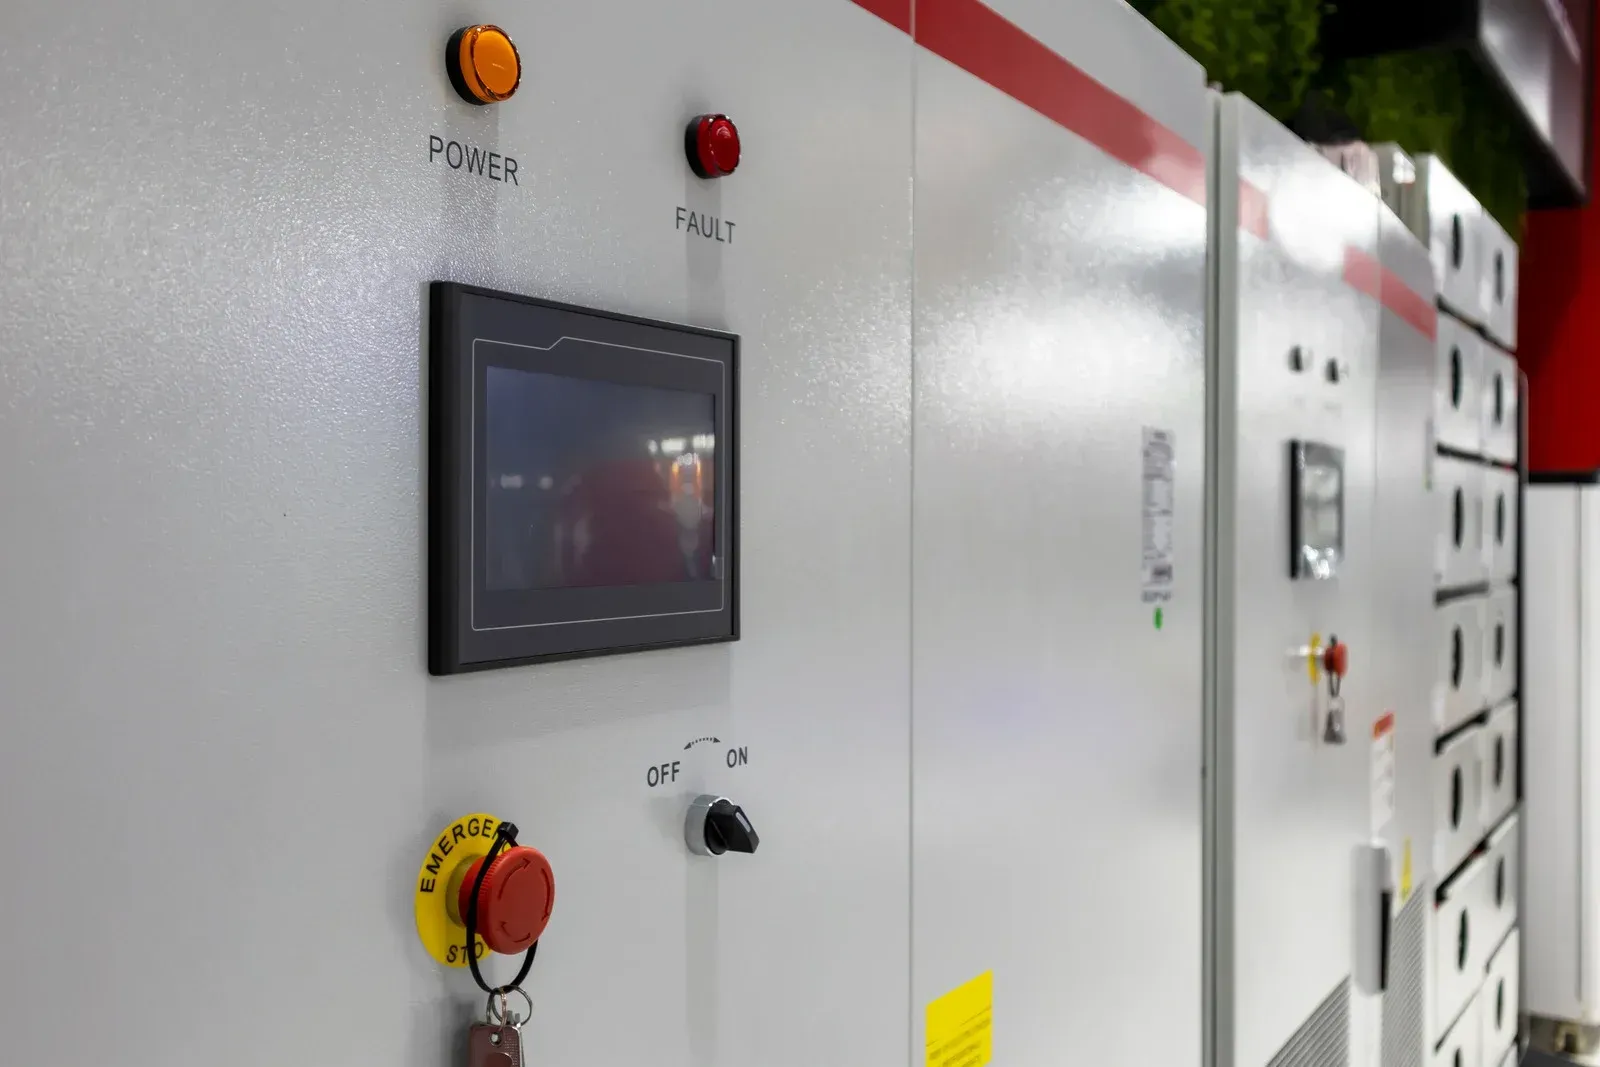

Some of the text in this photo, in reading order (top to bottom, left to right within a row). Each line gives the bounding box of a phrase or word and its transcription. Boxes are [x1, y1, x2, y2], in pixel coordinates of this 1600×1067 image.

[429, 134, 519, 186] POWER
[676, 206, 736, 244] FAULT
[726, 746, 748, 769] ON
[647, 761, 681, 787] OFF
[420, 818, 509, 893] EMERGE
[446, 941, 487, 964] STO
